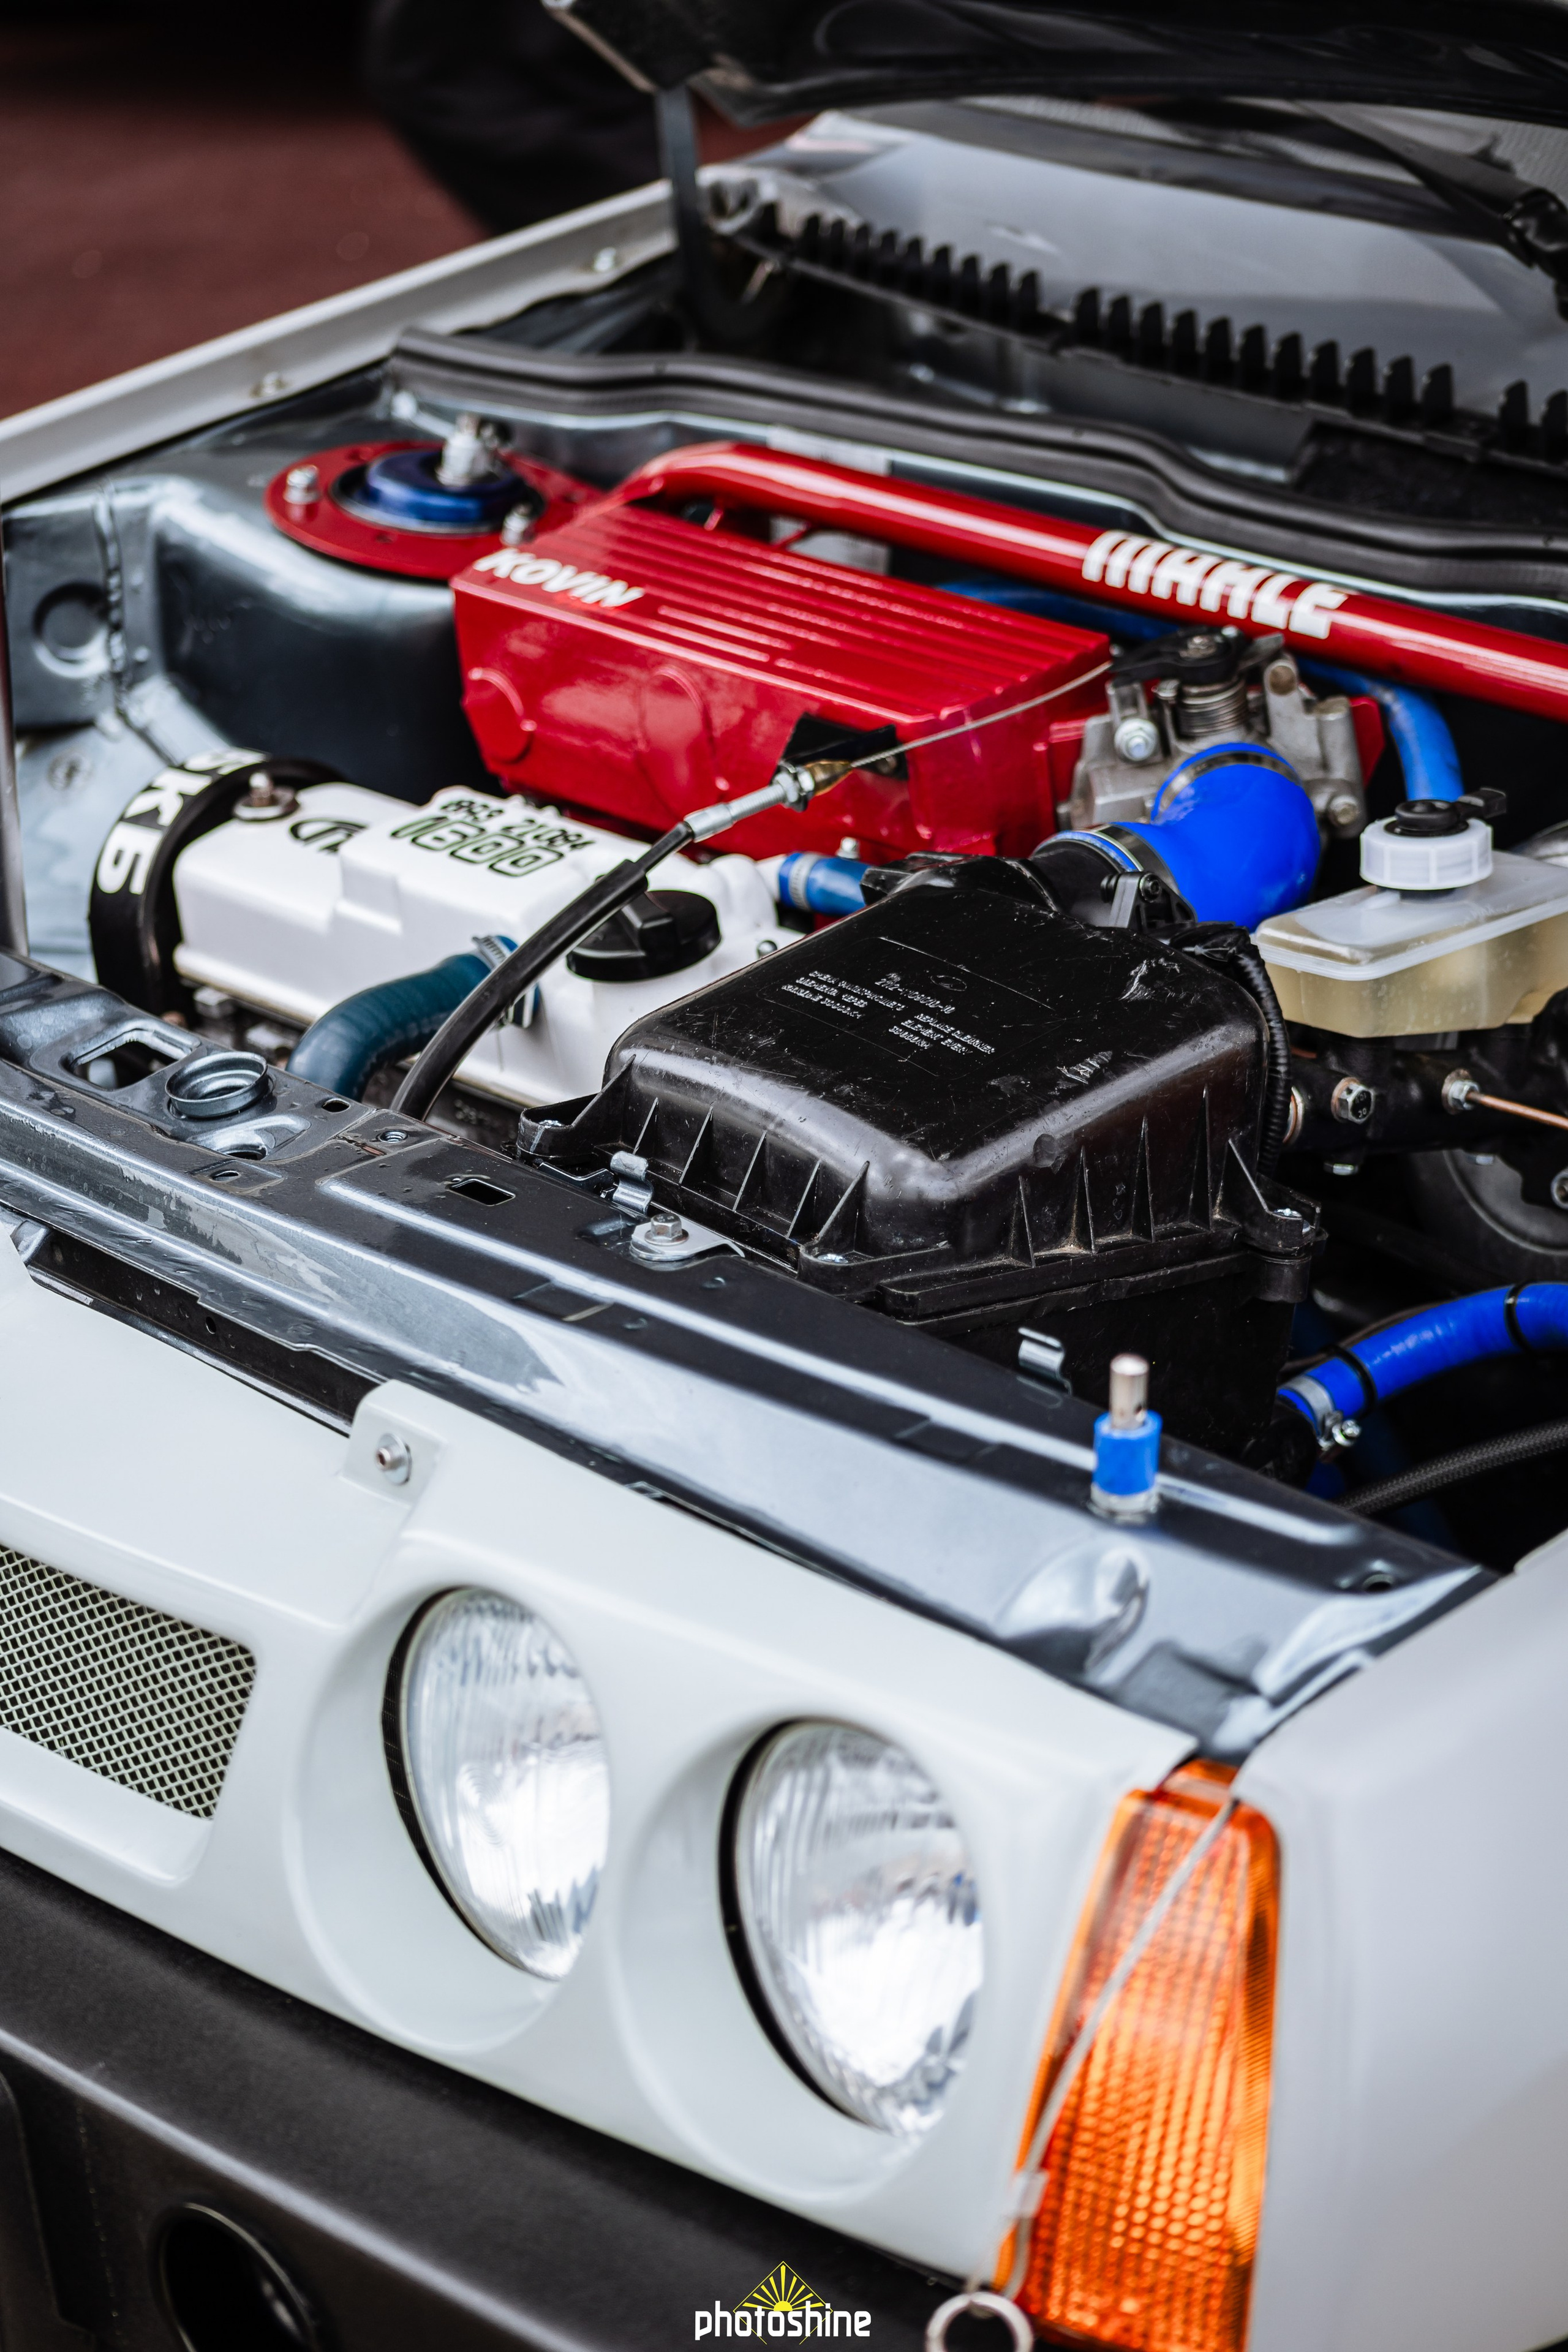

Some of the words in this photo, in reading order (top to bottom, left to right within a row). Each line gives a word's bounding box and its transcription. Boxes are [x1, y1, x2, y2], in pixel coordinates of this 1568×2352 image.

[473, 548, 645, 608] KOVIN
[1082, 530, 1348, 639] MAHLE
[390, 815, 564, 877] 1600
[901, 1019, 944, 1041] ELEMENT
[941, 1038, 973, 1055] EVERY
[914, 1014, 956, 1034] REPLACE
